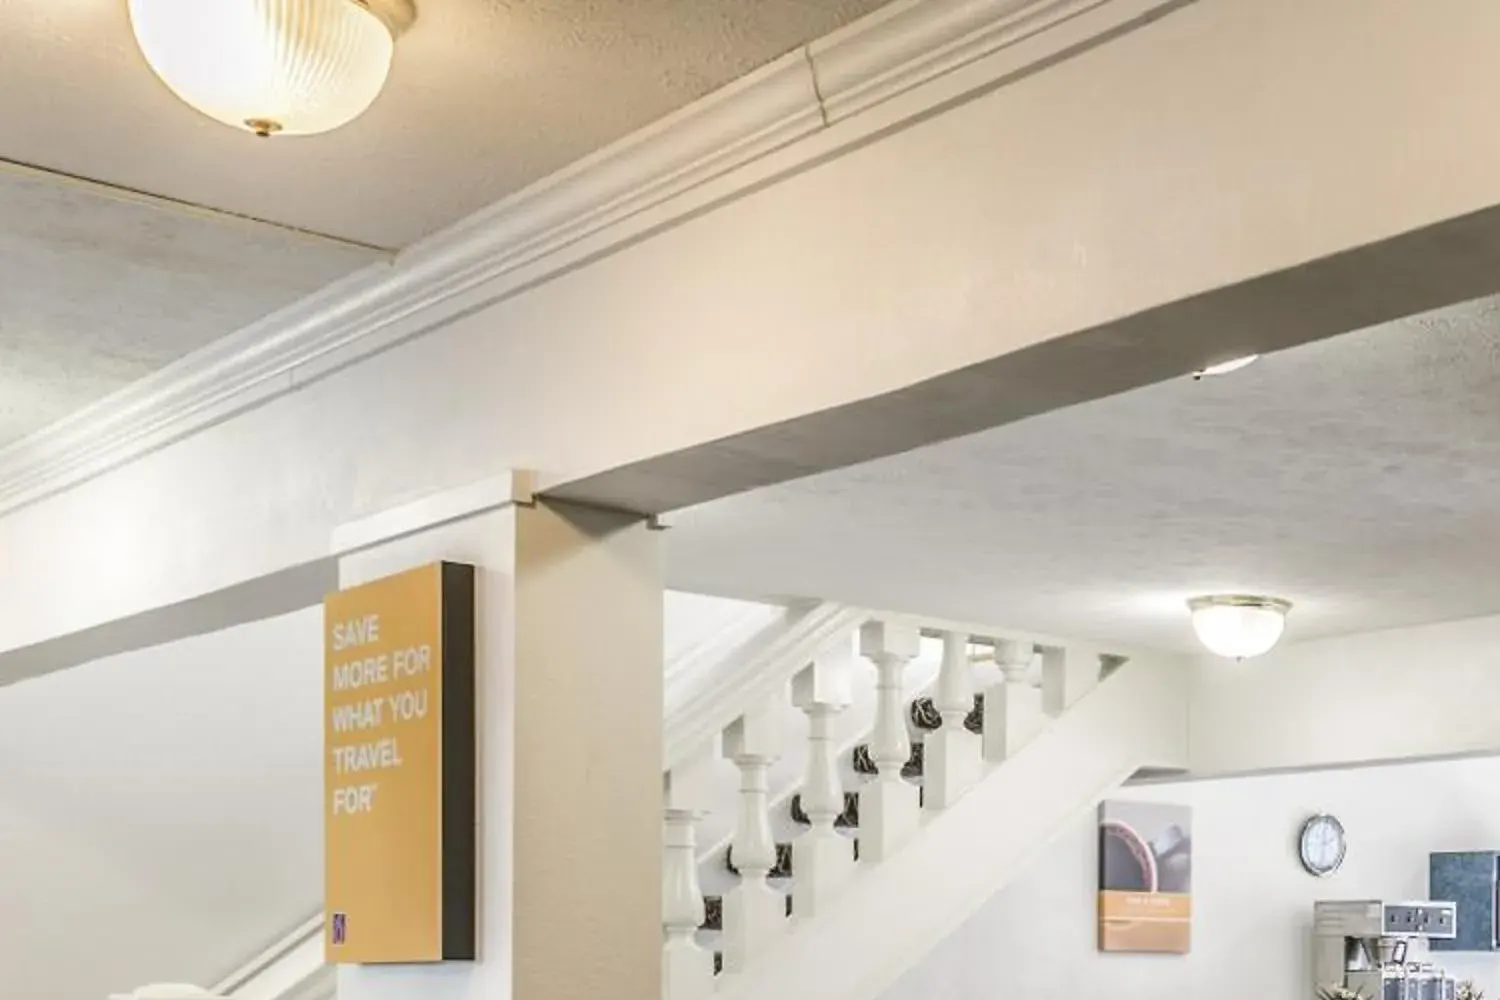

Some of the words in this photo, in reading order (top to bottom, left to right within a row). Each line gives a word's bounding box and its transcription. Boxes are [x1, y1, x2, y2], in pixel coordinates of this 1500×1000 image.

[332, 614, 379, 651] SAVE
[333, 657, 387, 691] MORE
[393, 645, 431, 680] FOR
[332, 697, 384, 733] WHAT
[389, 689, 428, 722] YOU
[332, 737, 403, 775] TRAVEL
[333, 785, 372, 816] FOR
